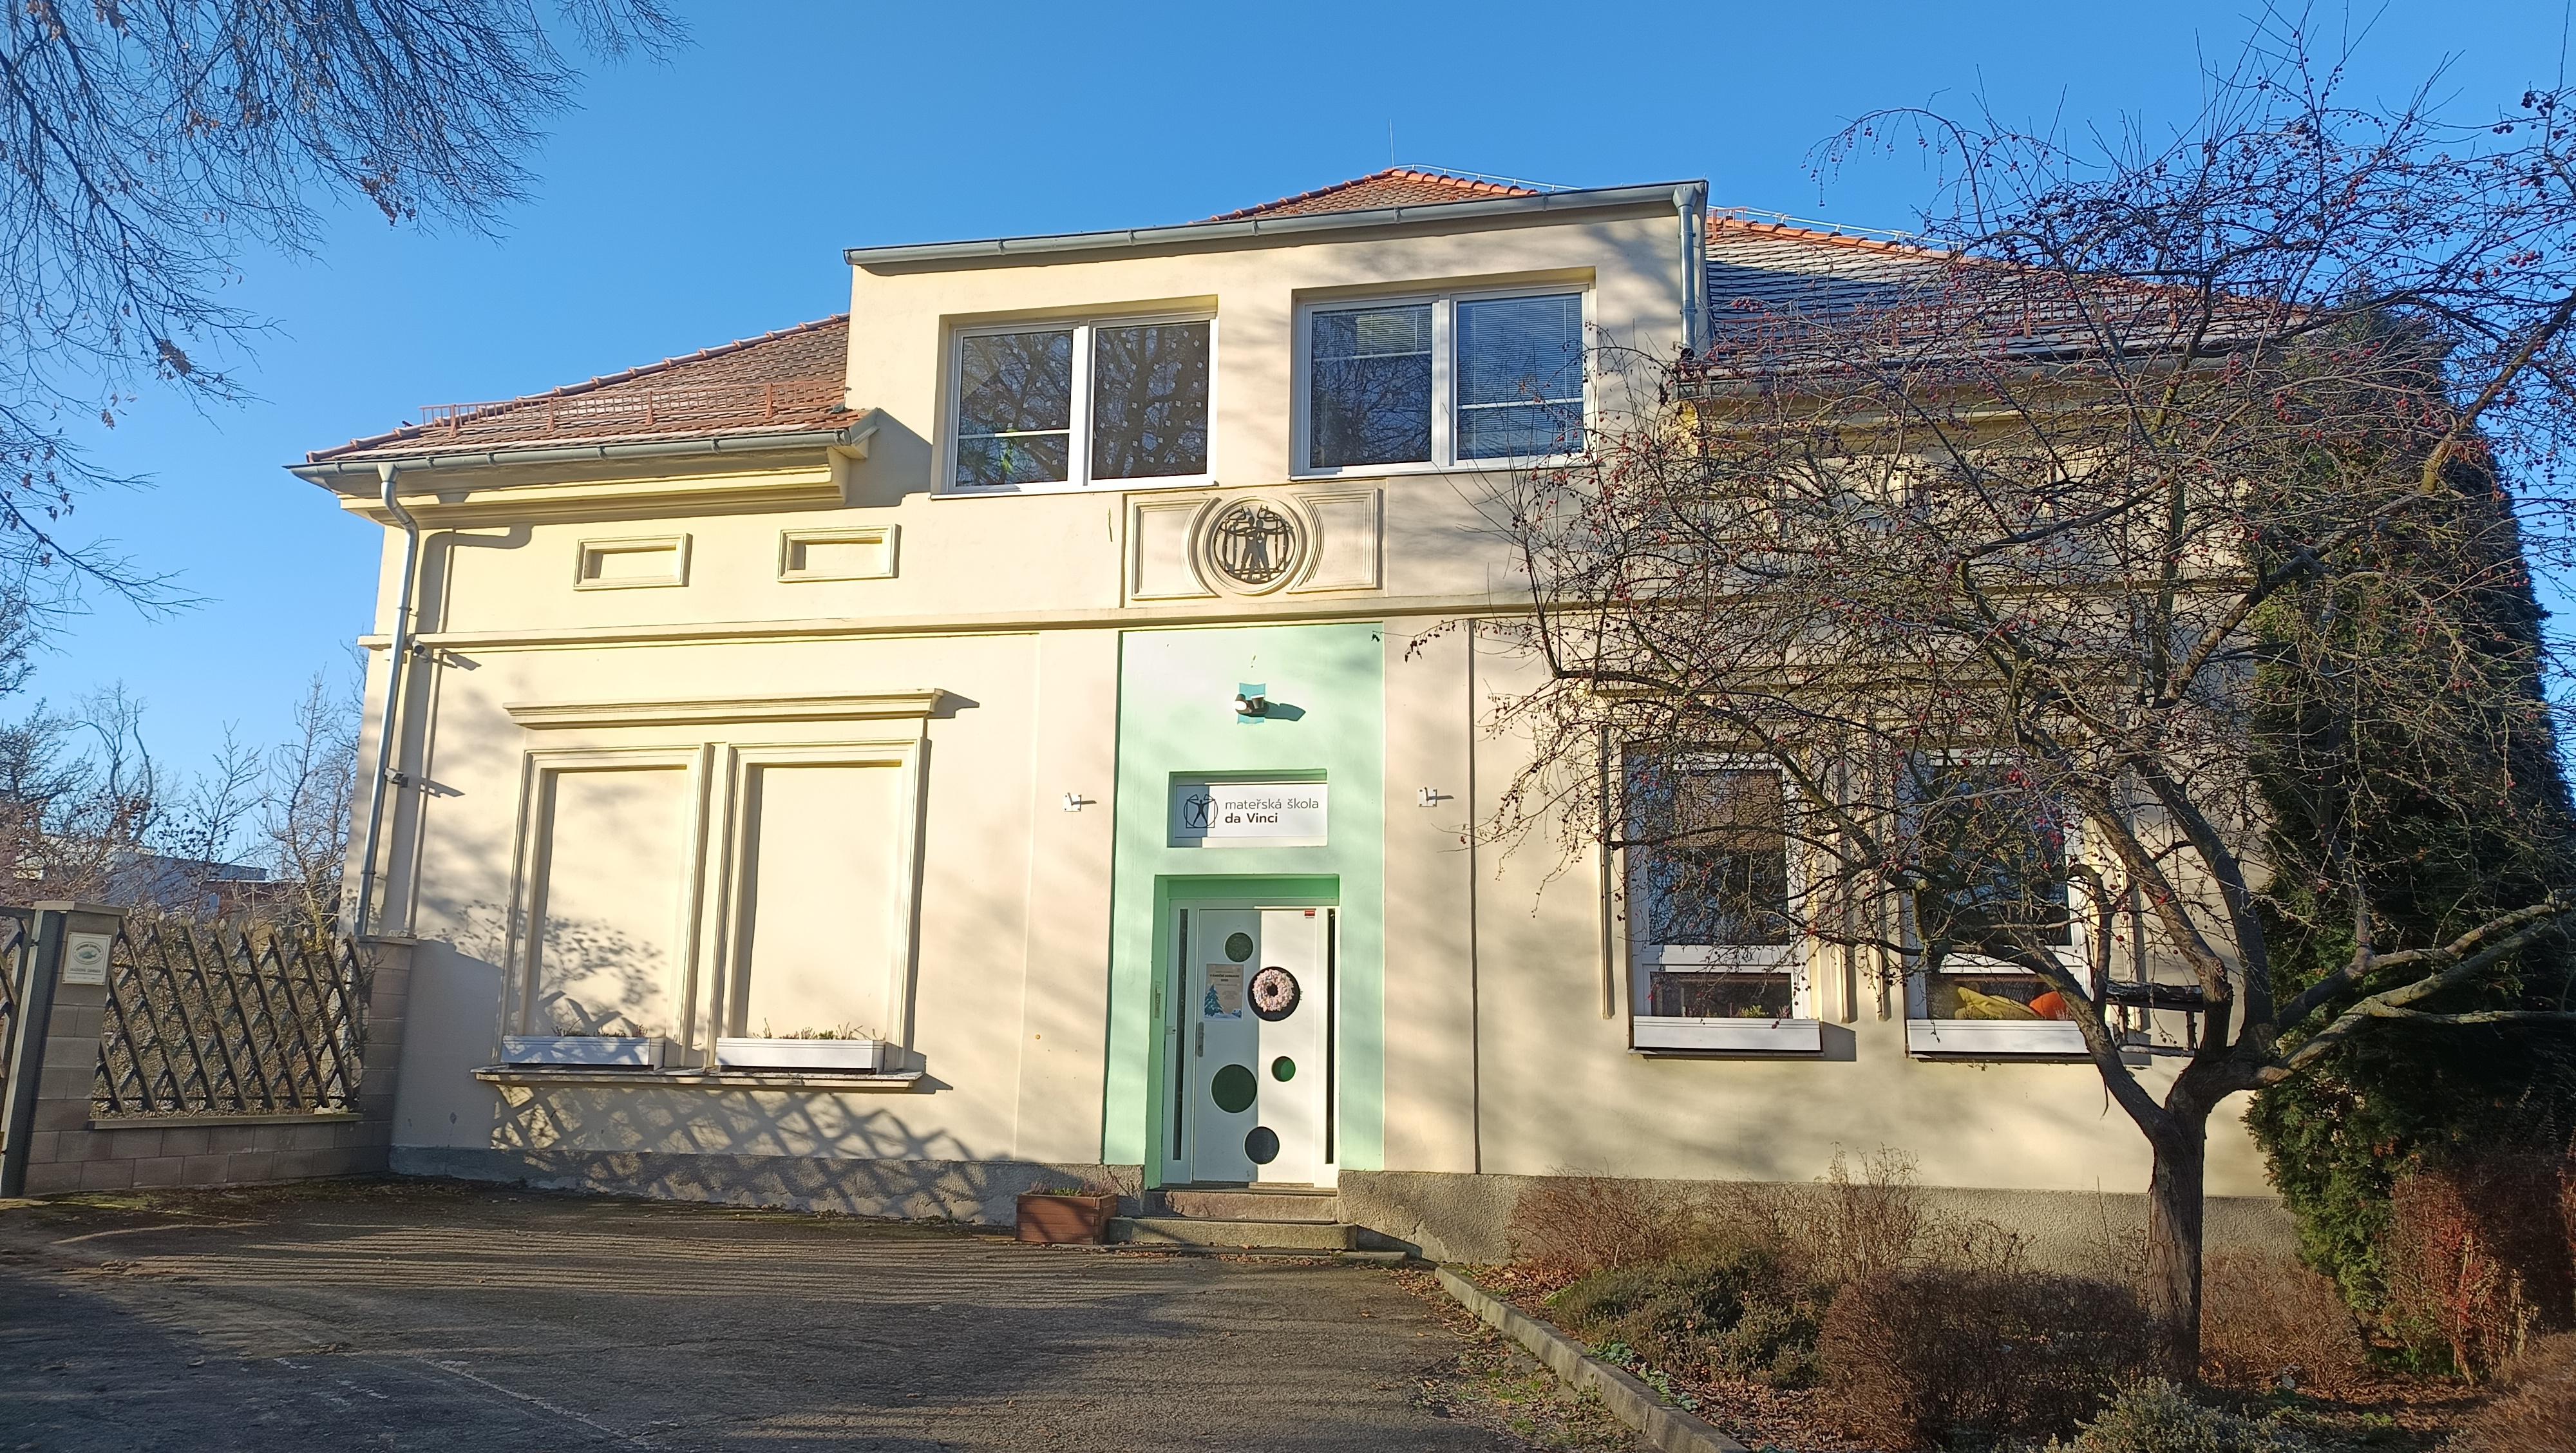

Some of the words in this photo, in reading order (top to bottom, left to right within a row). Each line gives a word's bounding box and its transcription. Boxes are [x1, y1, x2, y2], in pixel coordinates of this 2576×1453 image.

[1225, 798, 1282, 810] mateřská
[1287, 797, 1319, 809] škola
[1224, 813, 1241, 824] da
[1246, 812, 1278, 823] Vinci
